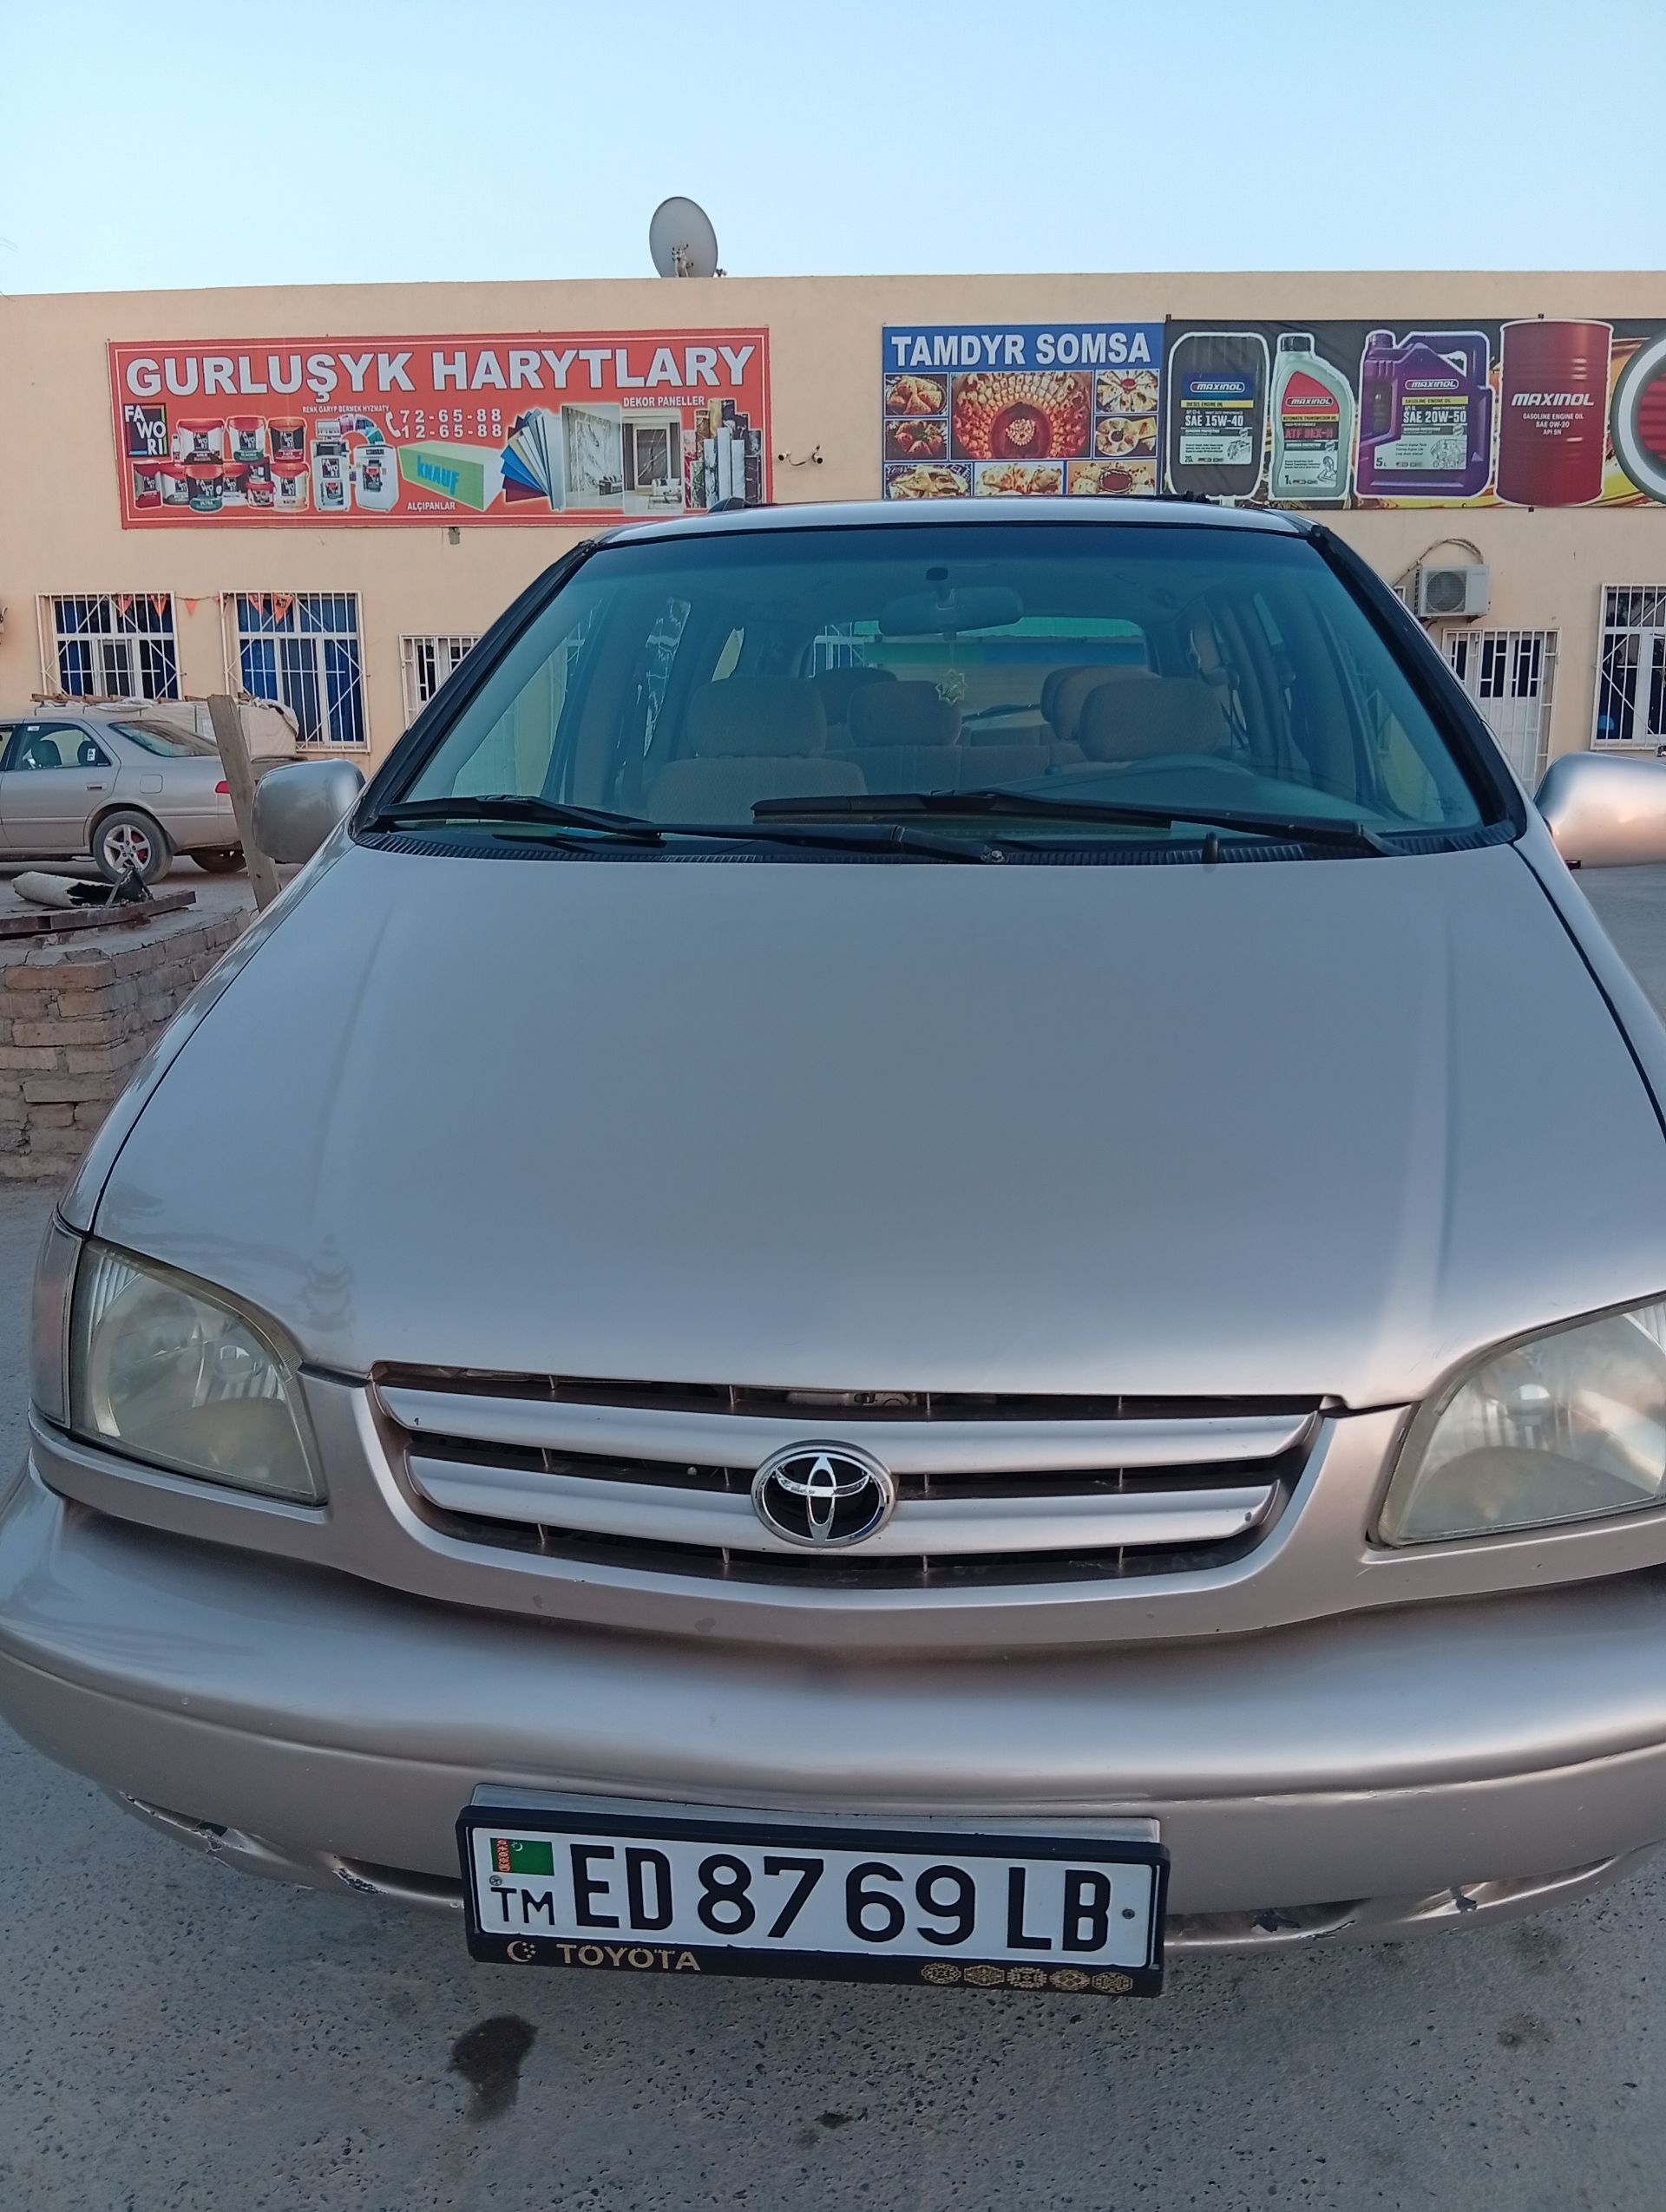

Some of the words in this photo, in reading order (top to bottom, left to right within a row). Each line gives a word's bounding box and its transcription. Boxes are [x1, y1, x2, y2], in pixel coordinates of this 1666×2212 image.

[891, 334, 1026, 368] TAMDYR
[1036, 332, 1151, 365] SOMSA
[126, 351, 416, 402] GURLUŞYK
[433, 346, 755, 390] HARYTLARY
[623, 396, 655, 407] DEKOR
[658, 396, 705, 407] PANELLER
[1512, 393, 1594, 406] MAXINOL
[362, 404, 389, 413] HYZMATY
[1184, 415, 1203, 427] SAE
[1205, 415, 1243, 427] 15W-40
[1403, 411, 1422, 423] SAE
[1425, 410, 1466, 423] 20W-50
[407, 501, 456, 512] ALÇIPANLAR
[490, 1887, 554, 1926] TM
[555, 1943, 700, 1971] TOYOTA
